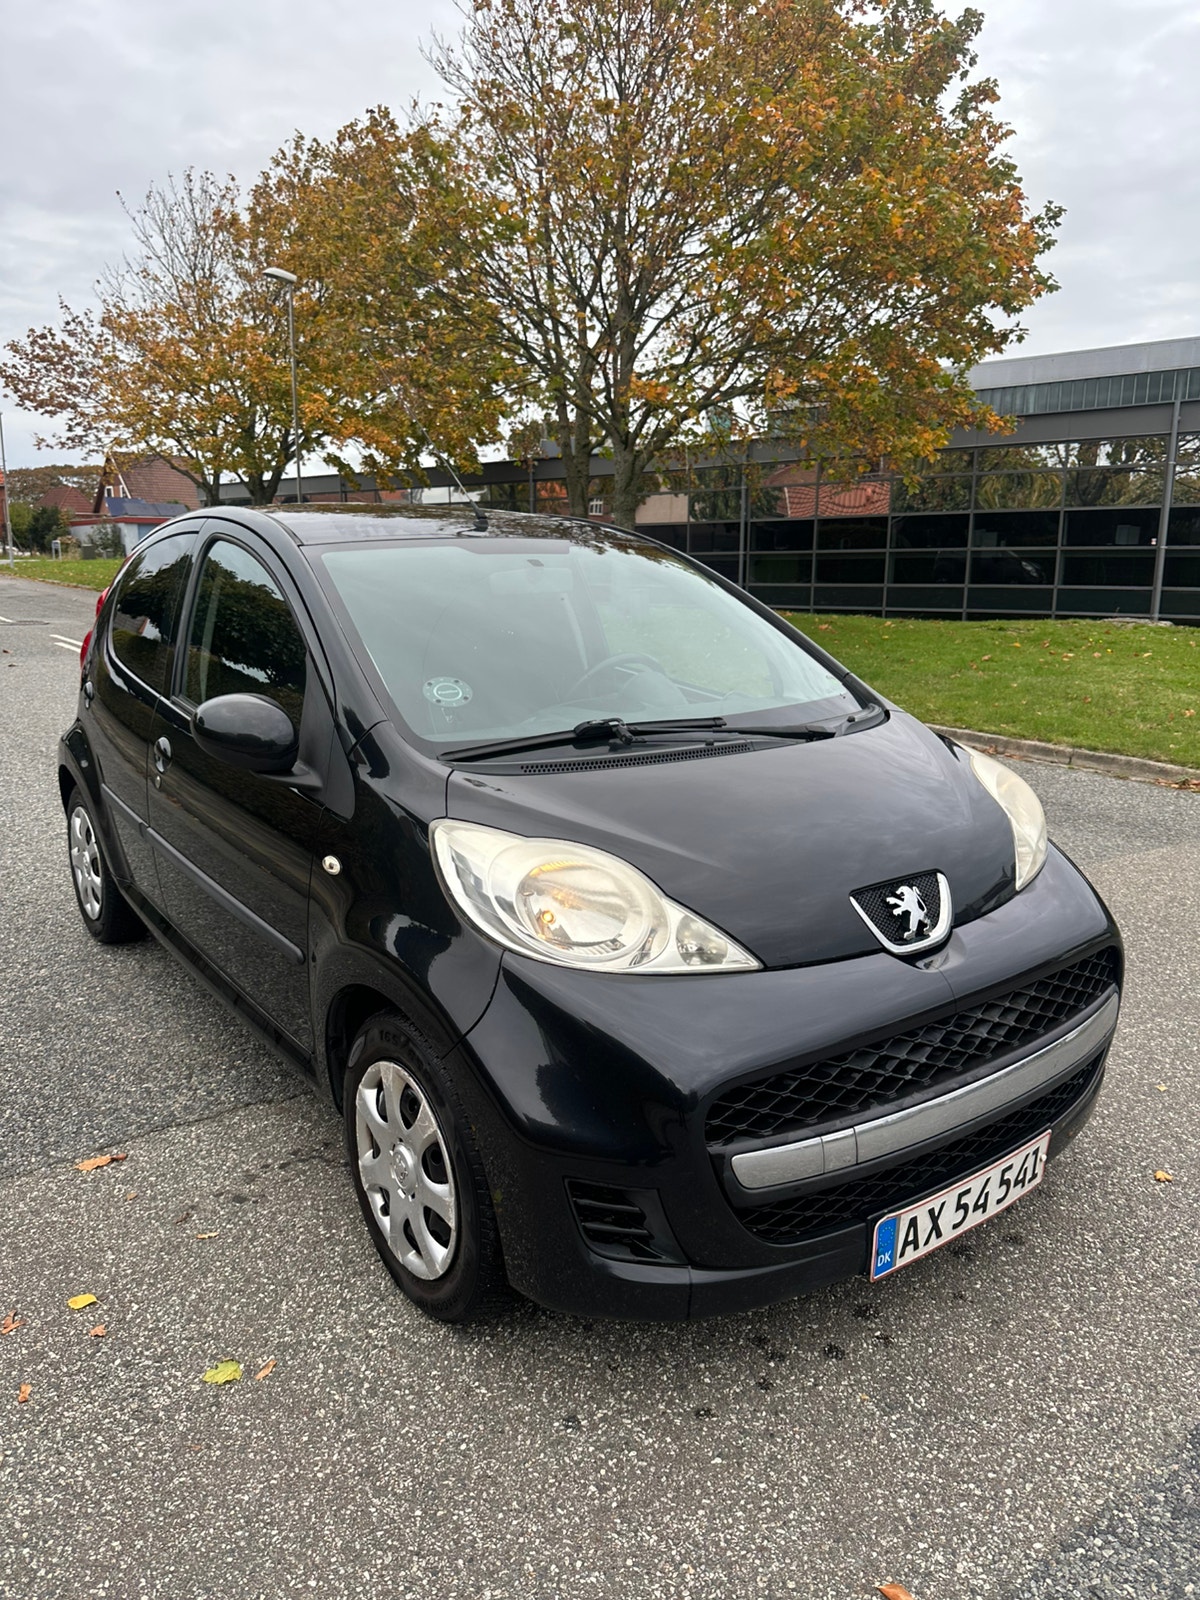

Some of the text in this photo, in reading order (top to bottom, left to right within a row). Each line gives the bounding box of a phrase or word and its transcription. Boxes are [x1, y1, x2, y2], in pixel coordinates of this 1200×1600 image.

[898, 1146, 1040, 1259] AX 54 541
[877, 1249, 892, 1267] DK
